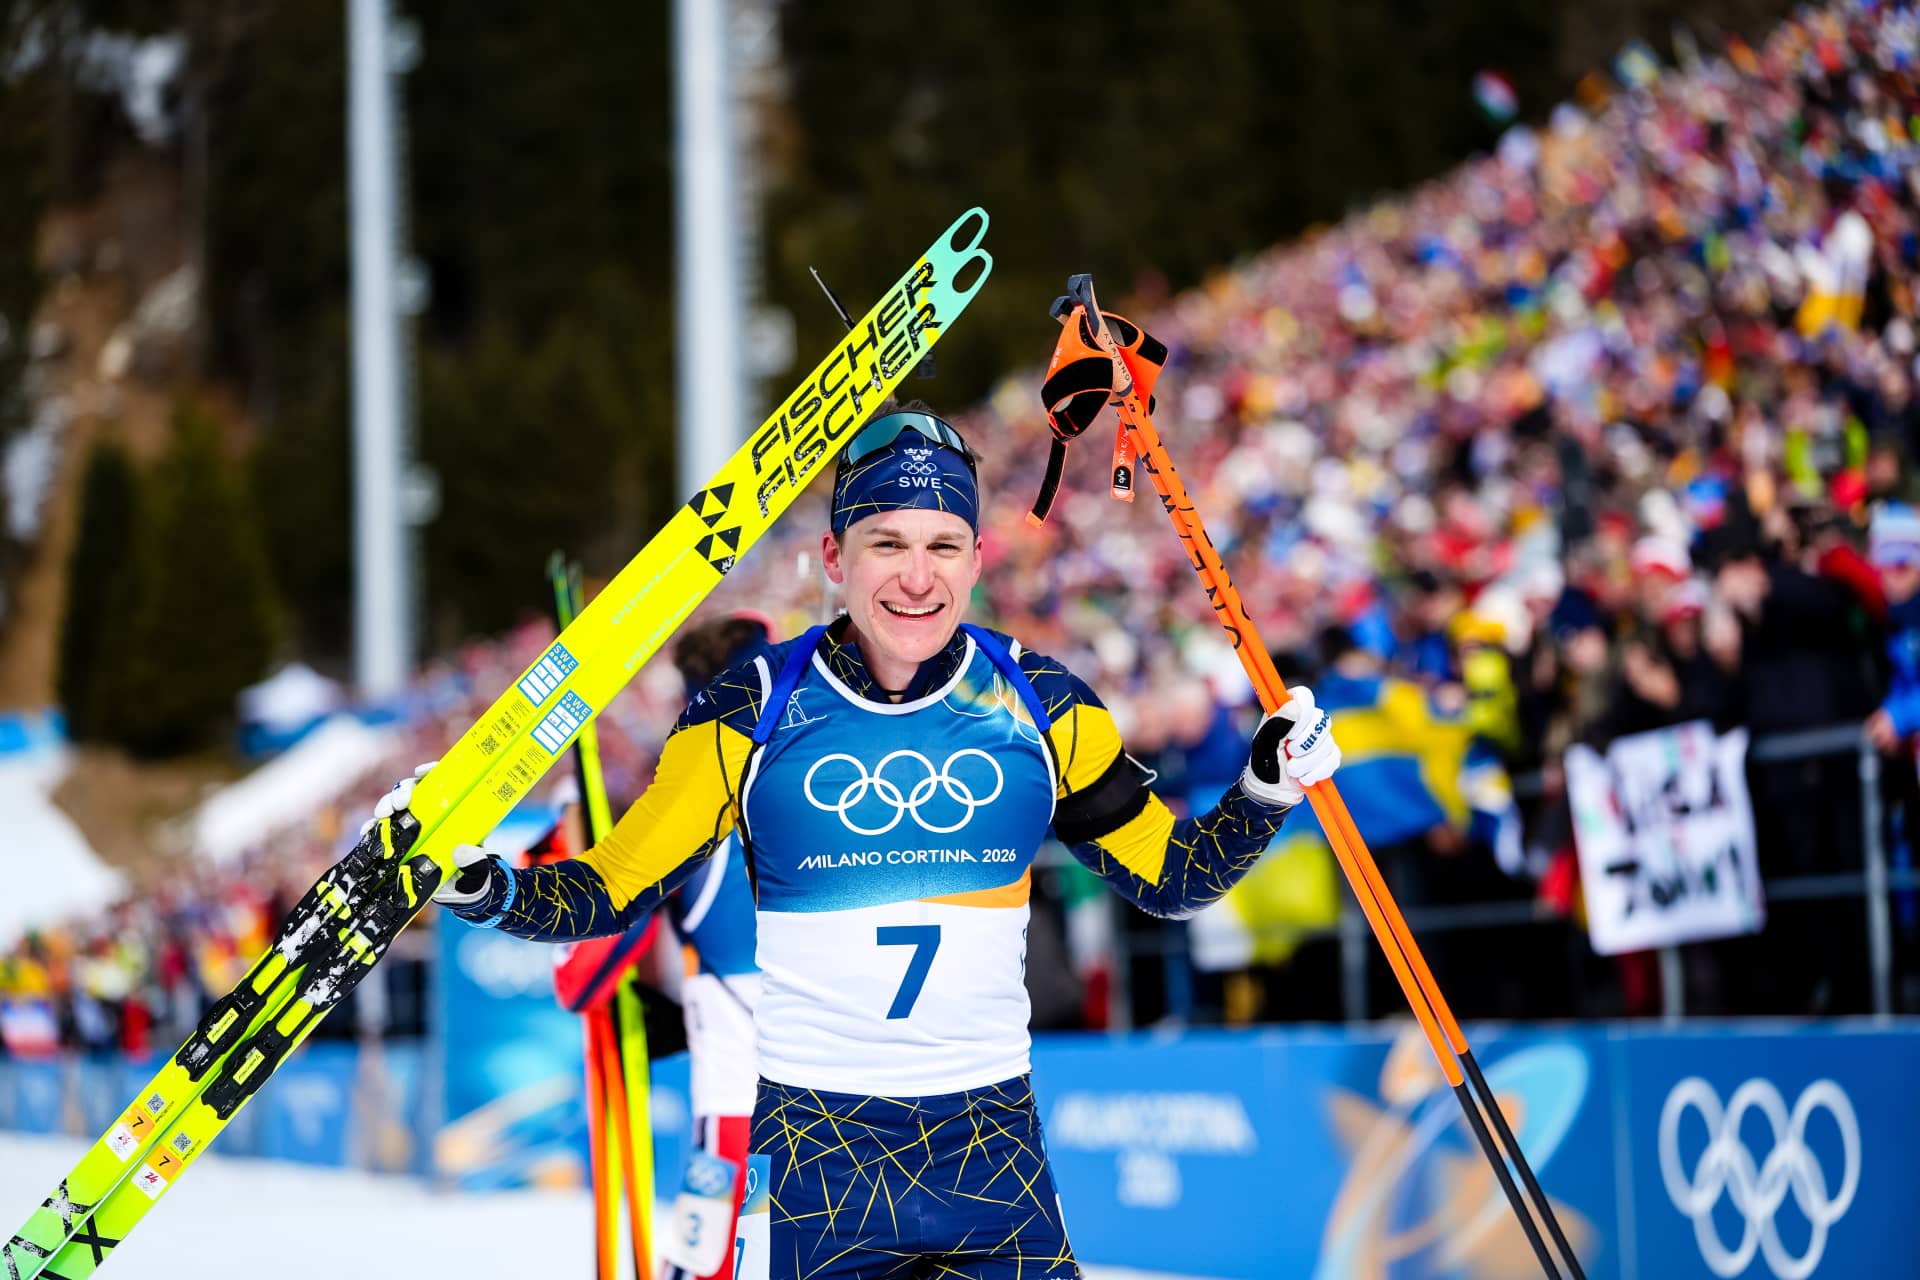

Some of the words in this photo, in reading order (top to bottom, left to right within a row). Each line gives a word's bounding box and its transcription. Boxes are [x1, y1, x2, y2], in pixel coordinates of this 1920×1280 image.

[751, 262, 938, 476] FISCHER
[757, 302, 943, 518] FISCHER
[898, 476, 942, 490] SWE
[554, 644, 577, 670] SWE
[565, 692, 590, 718] SWE
[797, 850, 882, 870] MILANO
[886, 849, 977, 864] CORTINA
[982, 849, 1016, 863] 2026
[876, 925, 941, 1020] 7
[132, 1116, 144, 1128] 7
[158, 1155, 170, 1167] 7
